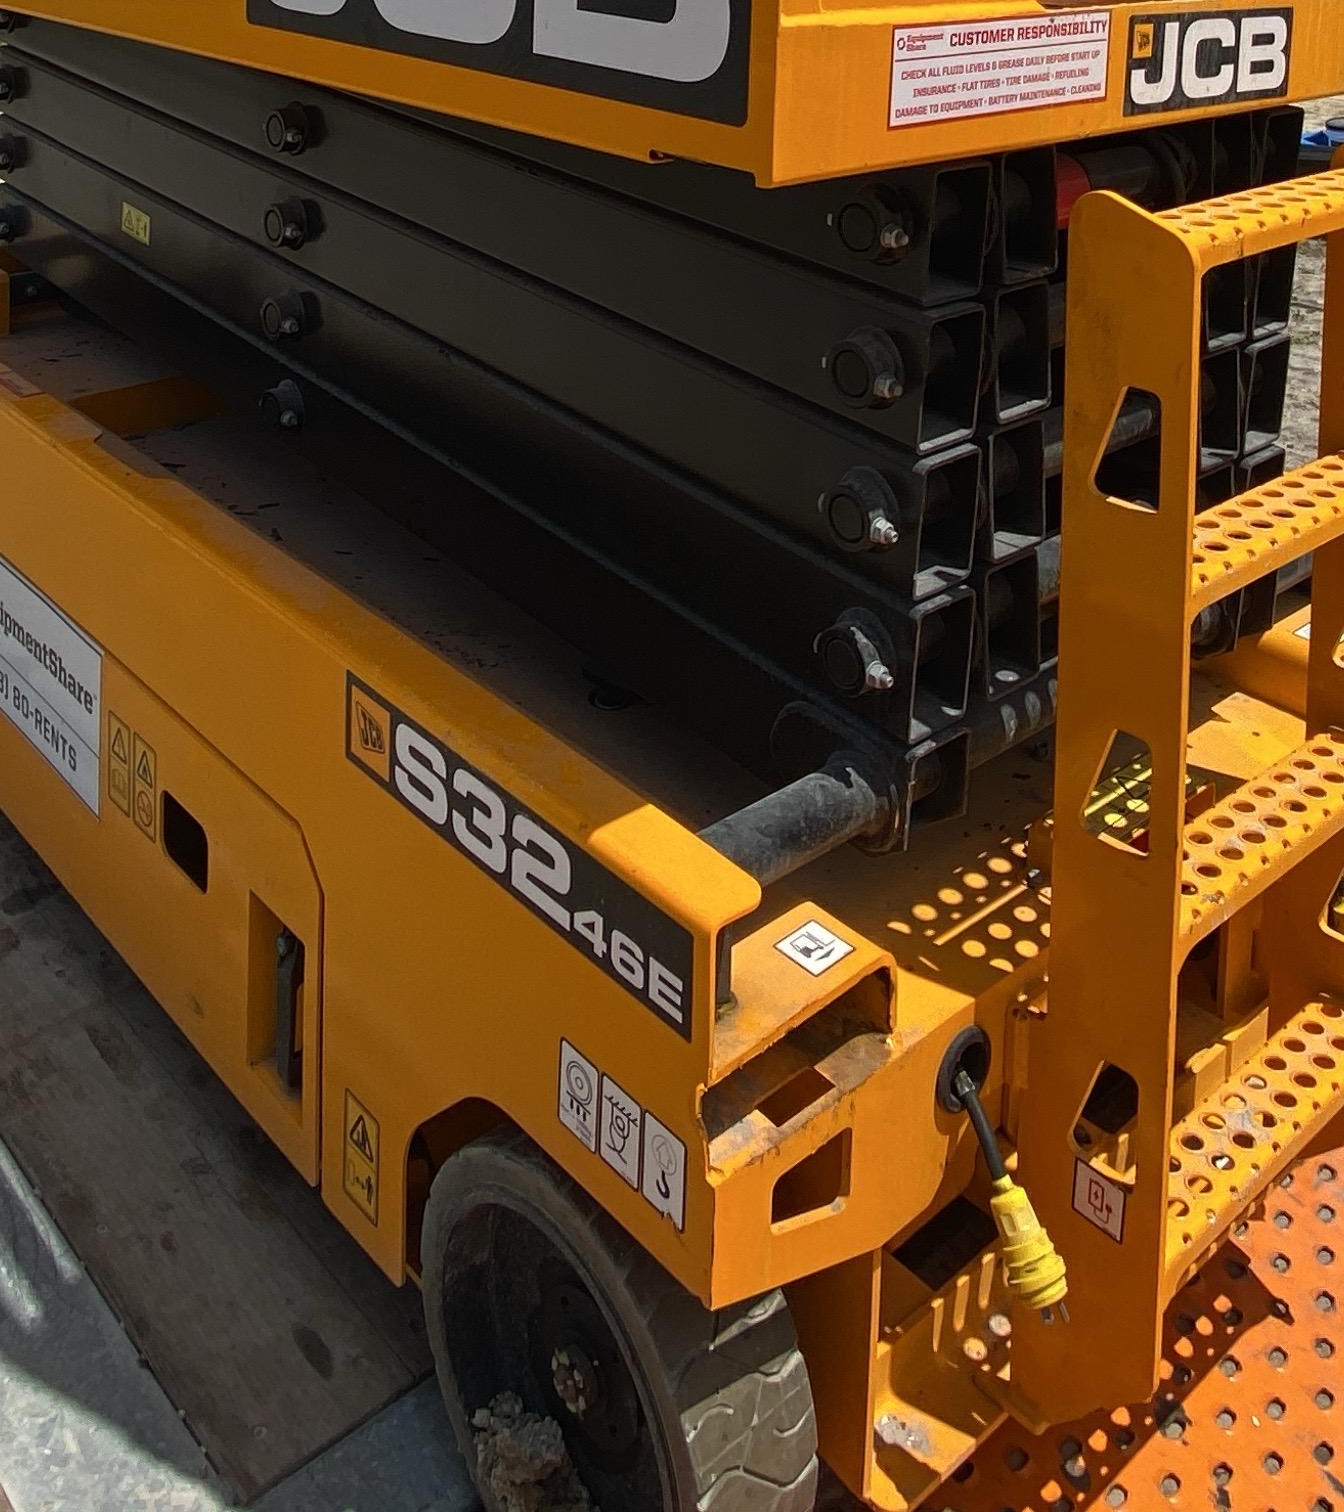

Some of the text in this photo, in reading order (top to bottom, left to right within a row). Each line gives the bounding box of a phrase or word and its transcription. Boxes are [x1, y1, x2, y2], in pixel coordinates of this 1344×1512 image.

[949, 19, 1108, 47] CUSTOMER RESPONSIBILITY
[901, 70, 927, 80] CHECK
[928, 67, 941, 77] ALL
[942, 64, 964, 76] FLUID
[965, 62, 991, 74] LEVELS
[998, 57, 1025, 70] GREASE
[1025, 56, 1045, 66] DAILY
[1046, 53, 1070, 64] BEFORE
[1071, 50, 1090, 61] START
[1091, 50, 1101, 59] UP
[1130, 16, 1288, 105] JCB
[913, 68, 1089, 98] INSURANCE FLAT TIRES TIRE DAMAGE REFUELING
[896, 83, 1101, 118] DAMAGE TO EQUIPMENT BATTERY MAINTENANCE CLEANING
[12, 685, 78, 773] 80-RENTS
